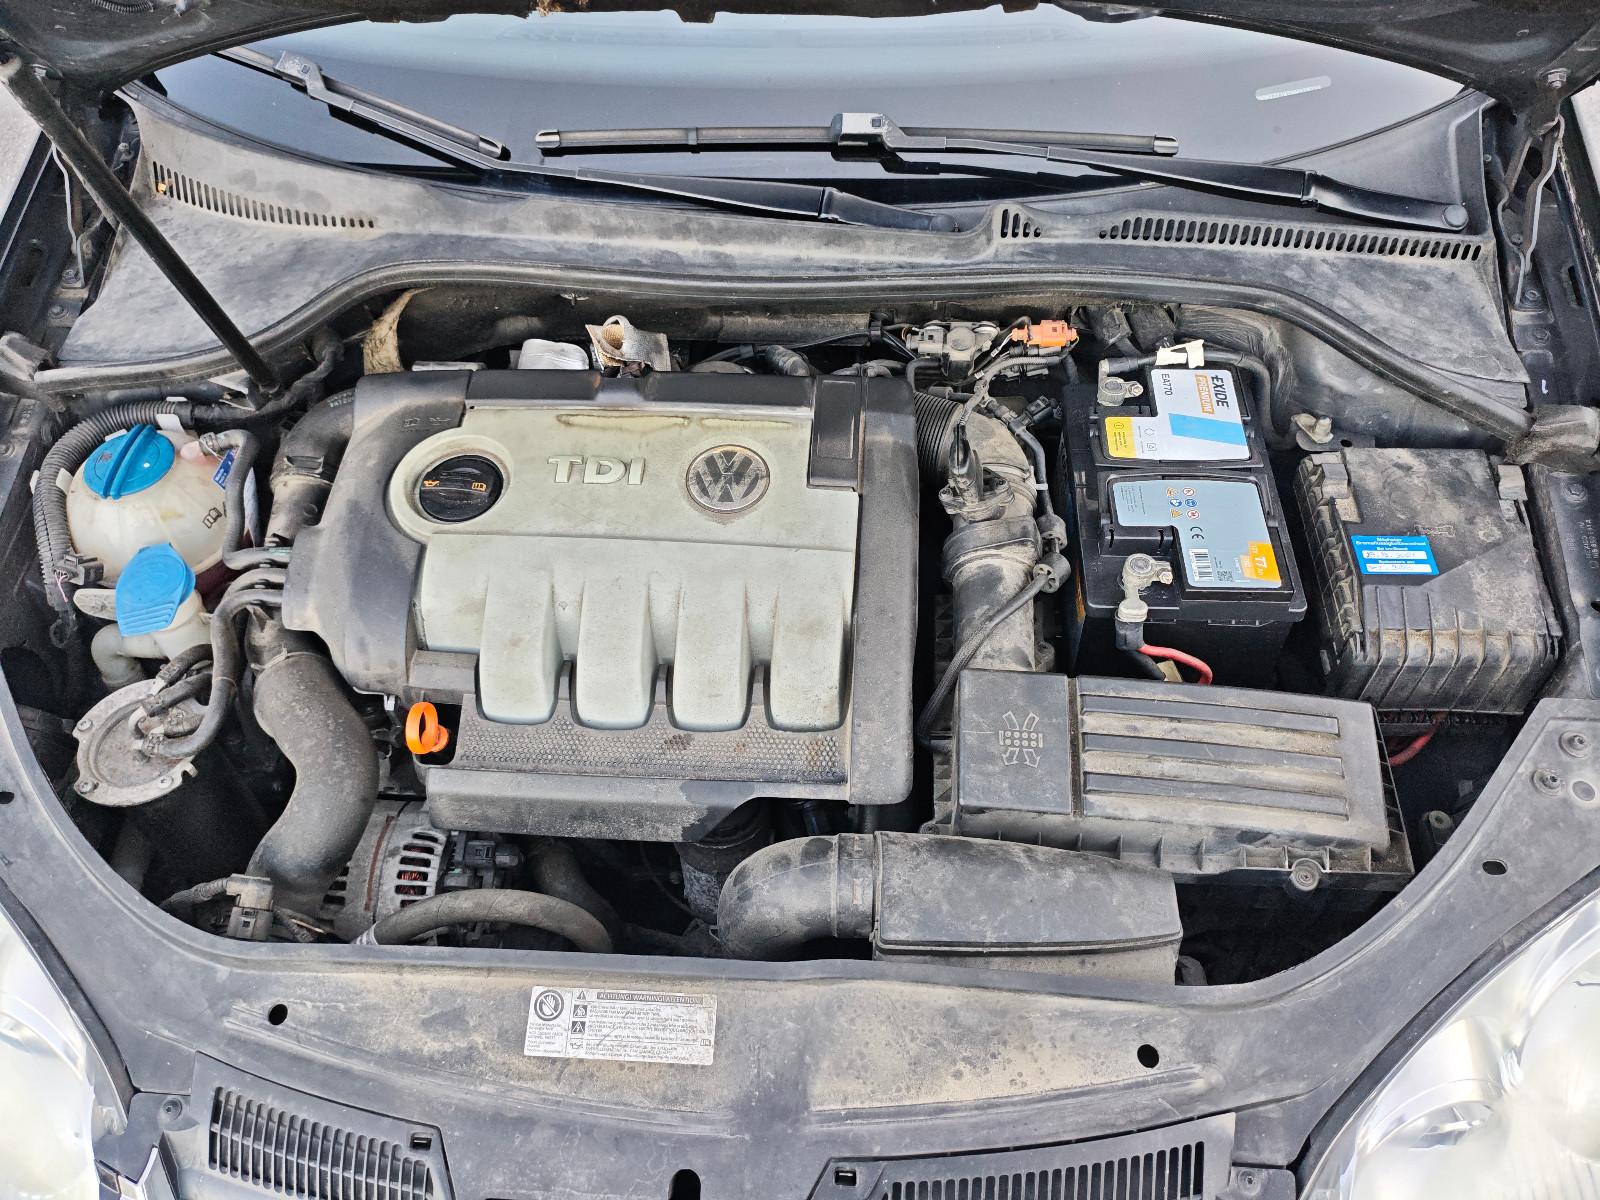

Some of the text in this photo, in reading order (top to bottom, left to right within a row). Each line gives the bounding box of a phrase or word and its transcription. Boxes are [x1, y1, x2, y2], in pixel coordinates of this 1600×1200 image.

[1161, 373, 1173, 396] EA770
[1197, 377, 1213, 413] PREMIUM
[1211, 375, 1229, 408] EXIDE
[547, 455, 646, 485] TDI
[687, 446, 769, 511] VW
[599, 992, 632, 1000] ACHTUNG!
[633, 993, 664, 1002] WARNING!
